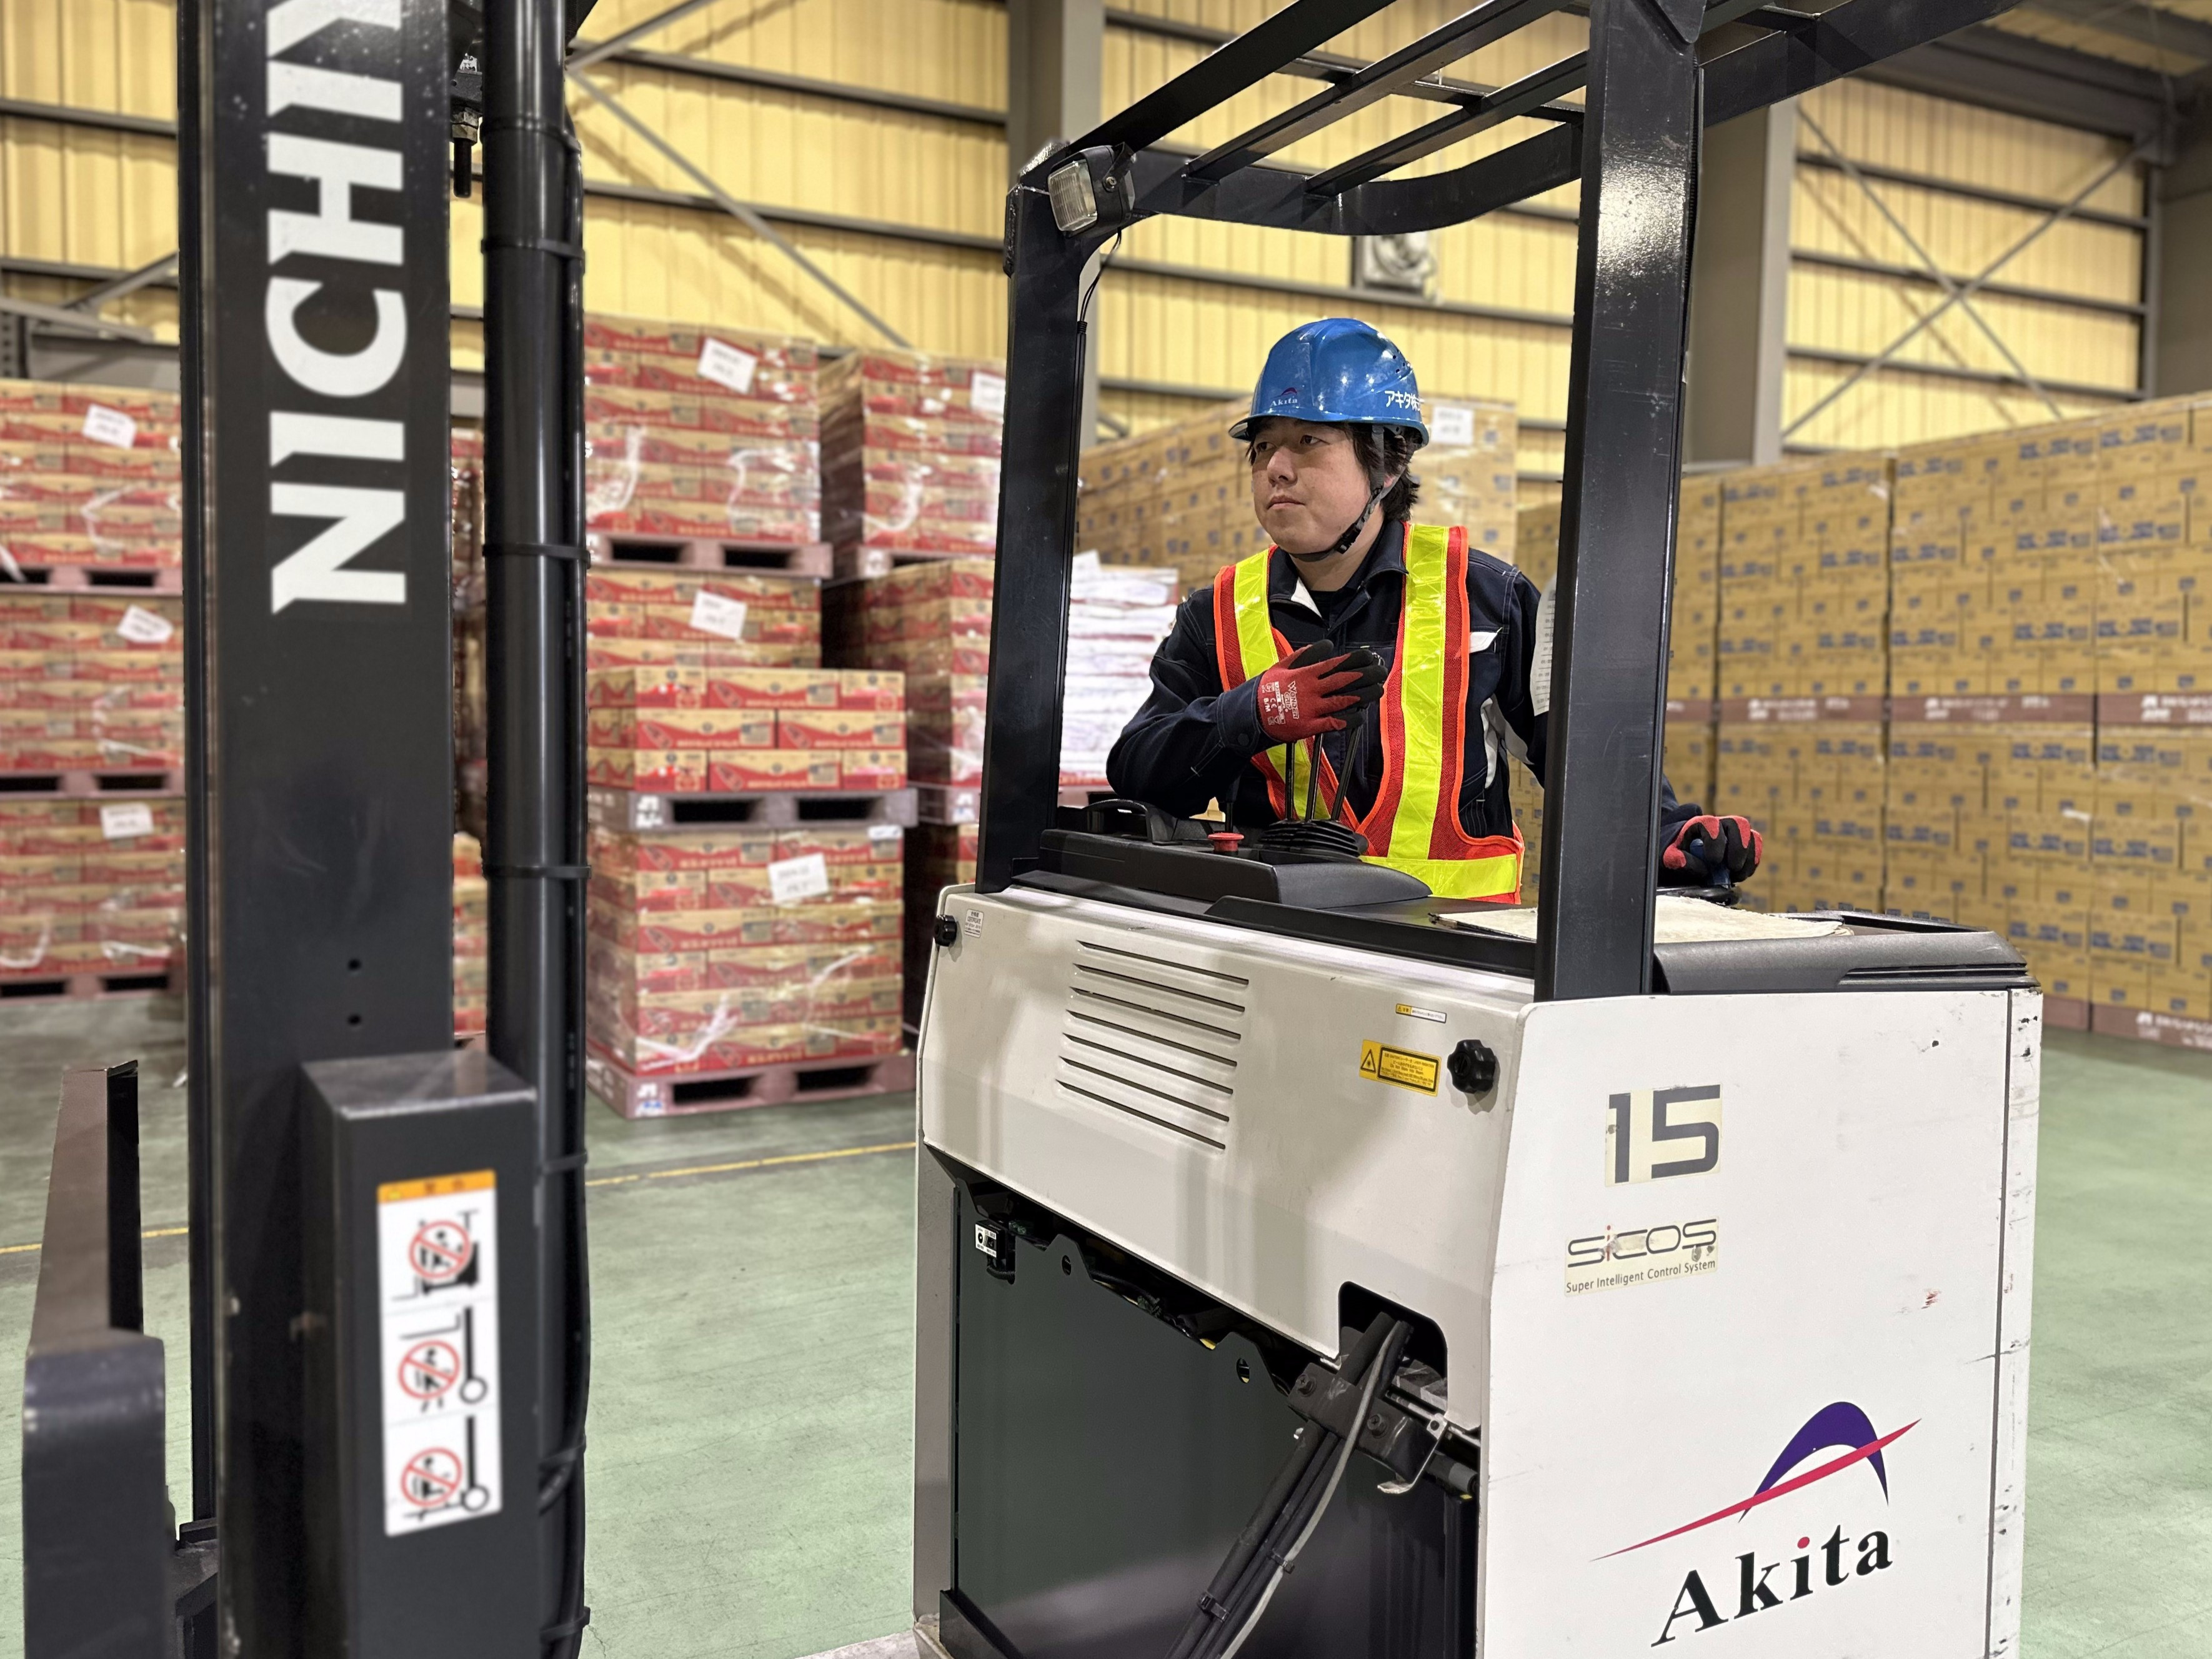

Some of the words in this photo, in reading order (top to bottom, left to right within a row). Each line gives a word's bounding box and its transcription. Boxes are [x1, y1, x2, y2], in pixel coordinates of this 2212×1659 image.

[1270, 397, 1298, 407] Akita
[1384, 390, 1421, 412] アキタ株
[1284, 692, 1293, 710] GRIP
[1287, 680, 1299, 719] WONDER
[1608, 1084, 1720, 1183] 15
[1566, 1280, 1595, 1293] Super
[1597, 1272, 1644, 1288] Intelligent
[1647, 1263, 1681, 1279] Control
[1684, 1259, 1716, 1275] System
[1651, 1525, 1893, 1648] Akita
